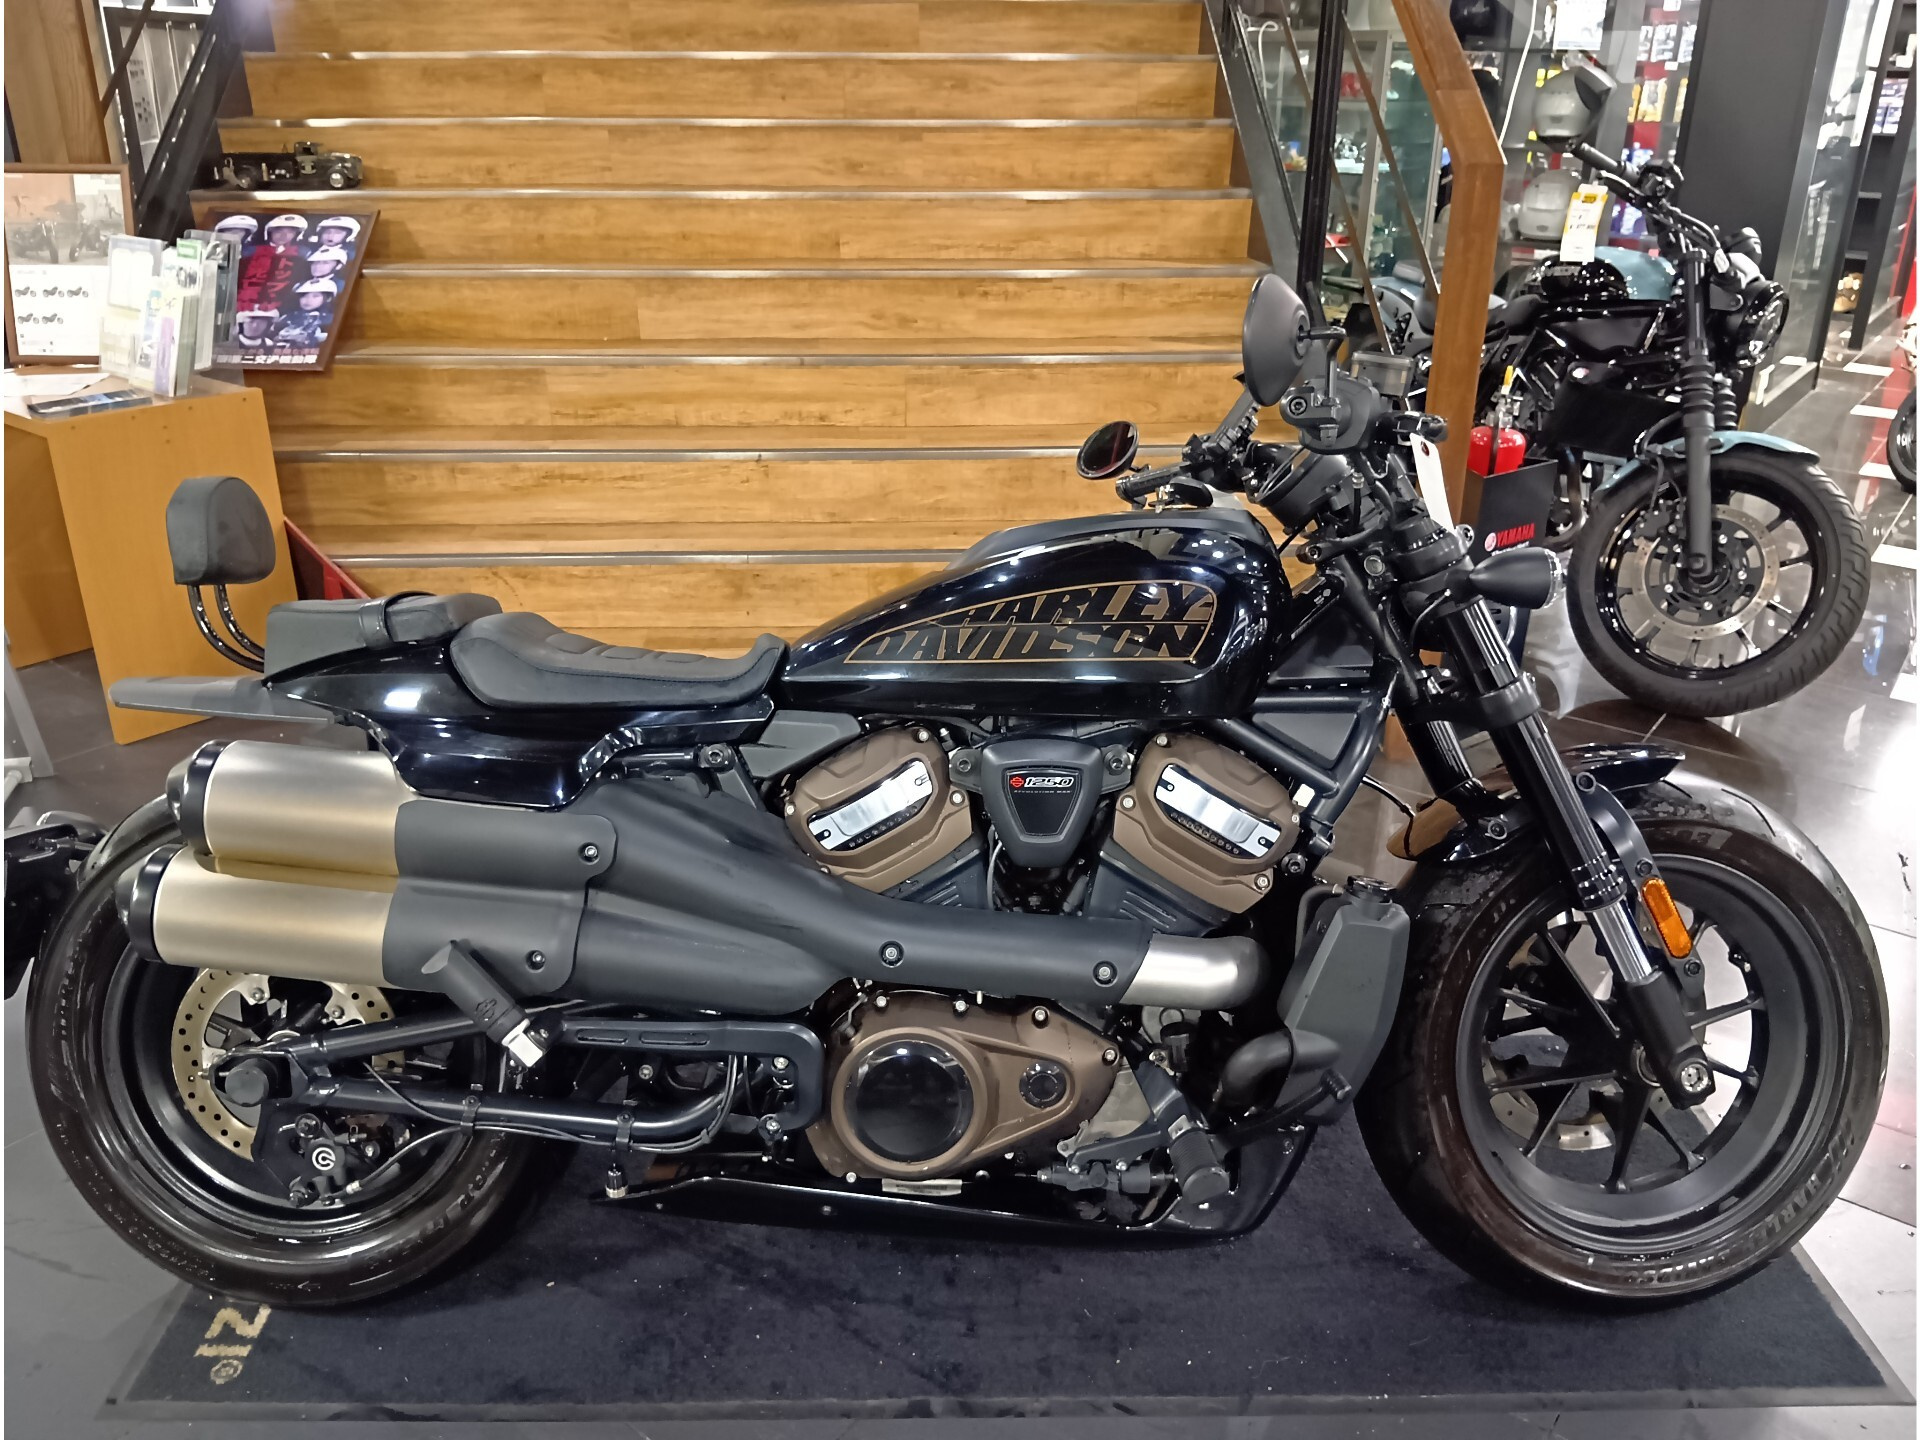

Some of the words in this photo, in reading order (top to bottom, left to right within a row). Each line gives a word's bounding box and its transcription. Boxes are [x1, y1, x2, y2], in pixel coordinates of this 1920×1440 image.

[1497, 523, 1534, 547] YAMAHA
[944, 583, 1213, 626] HARLEY
[860, 625, 1208, 660] DAVIDSON
[1024, 776, 1074, 788] 1250
